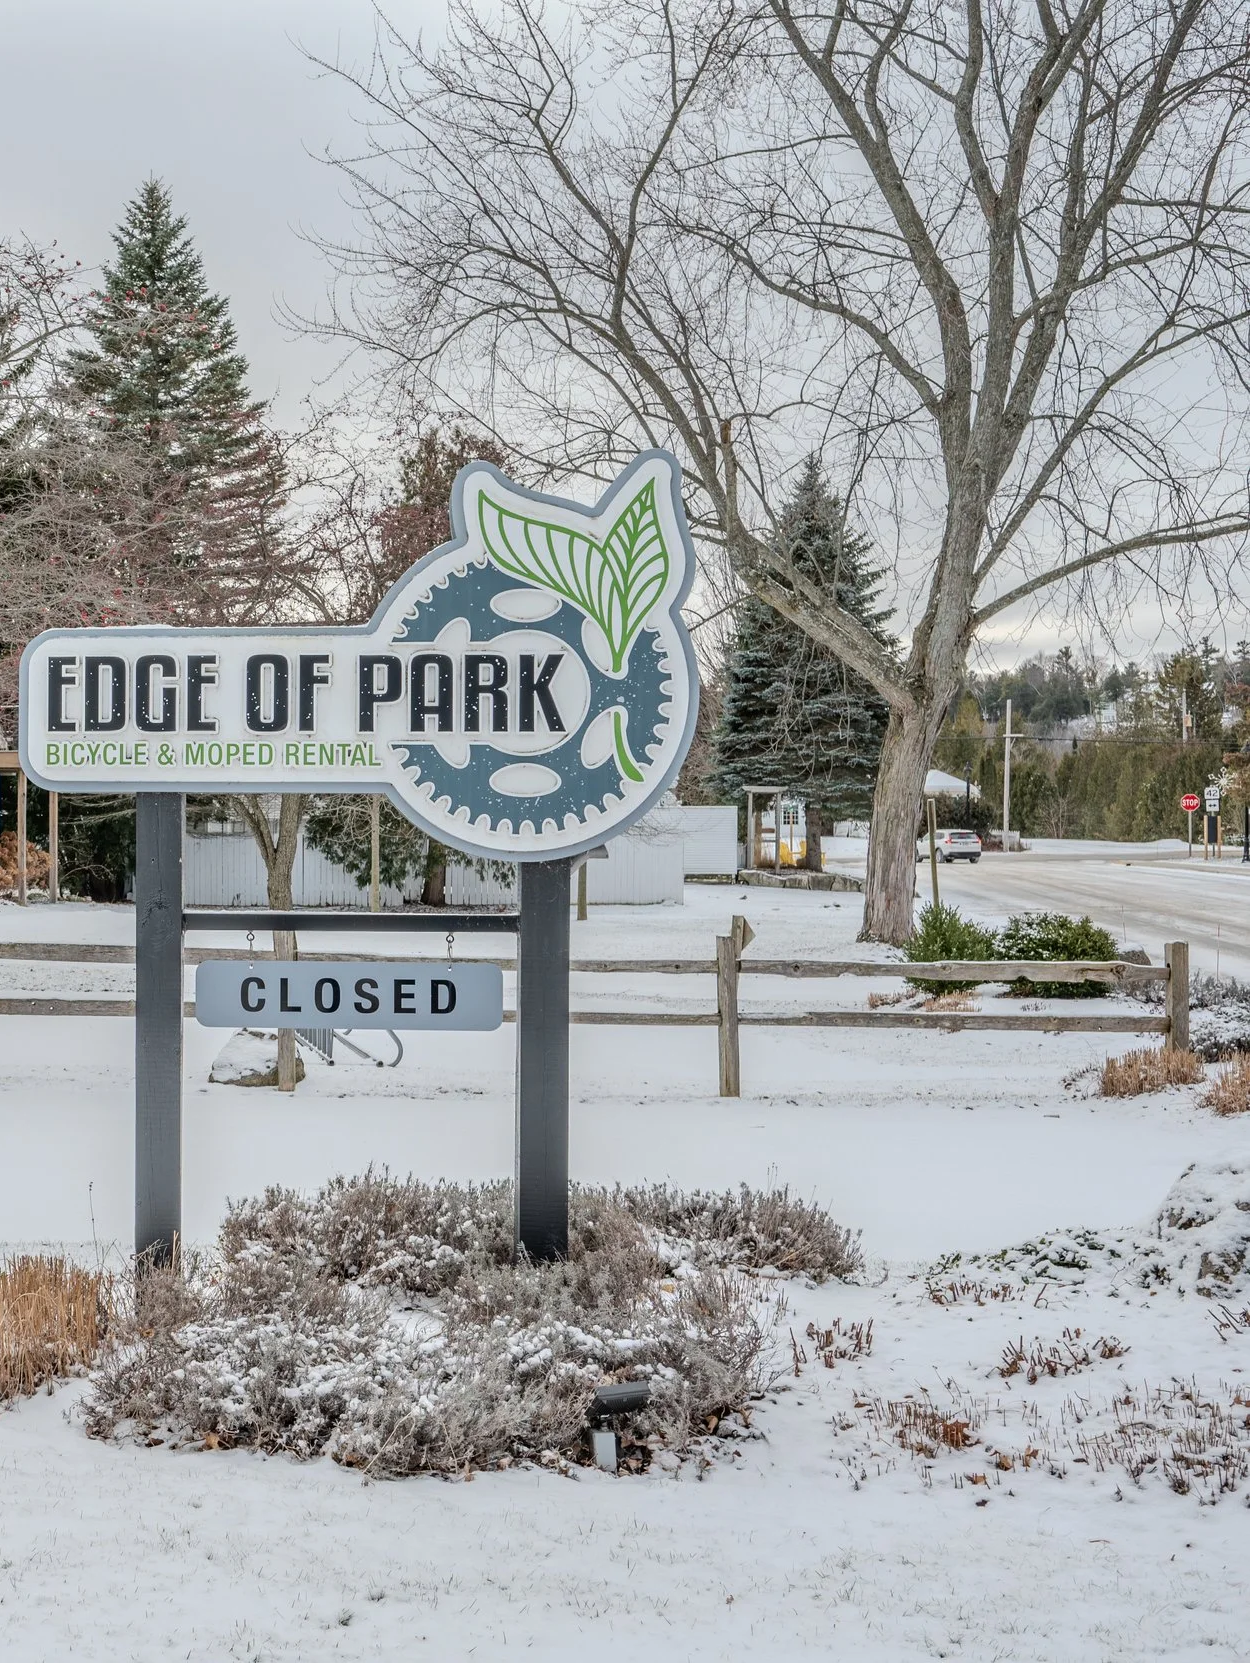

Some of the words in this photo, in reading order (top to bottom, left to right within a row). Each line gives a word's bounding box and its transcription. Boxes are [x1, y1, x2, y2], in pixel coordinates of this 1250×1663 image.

[47, 654, 219, 732] EDGE
[246, 654, 332, 732] OF
[358, 654, 567, 733] PARK
[46, 743, 147, 766] BICYCLE
[157, 743, 174, 766] &
[185, 743, 273, 766] MOPED
[285, 743, 382, 767] RENTAL
[240, 976, 458, 1014] CLOSED
